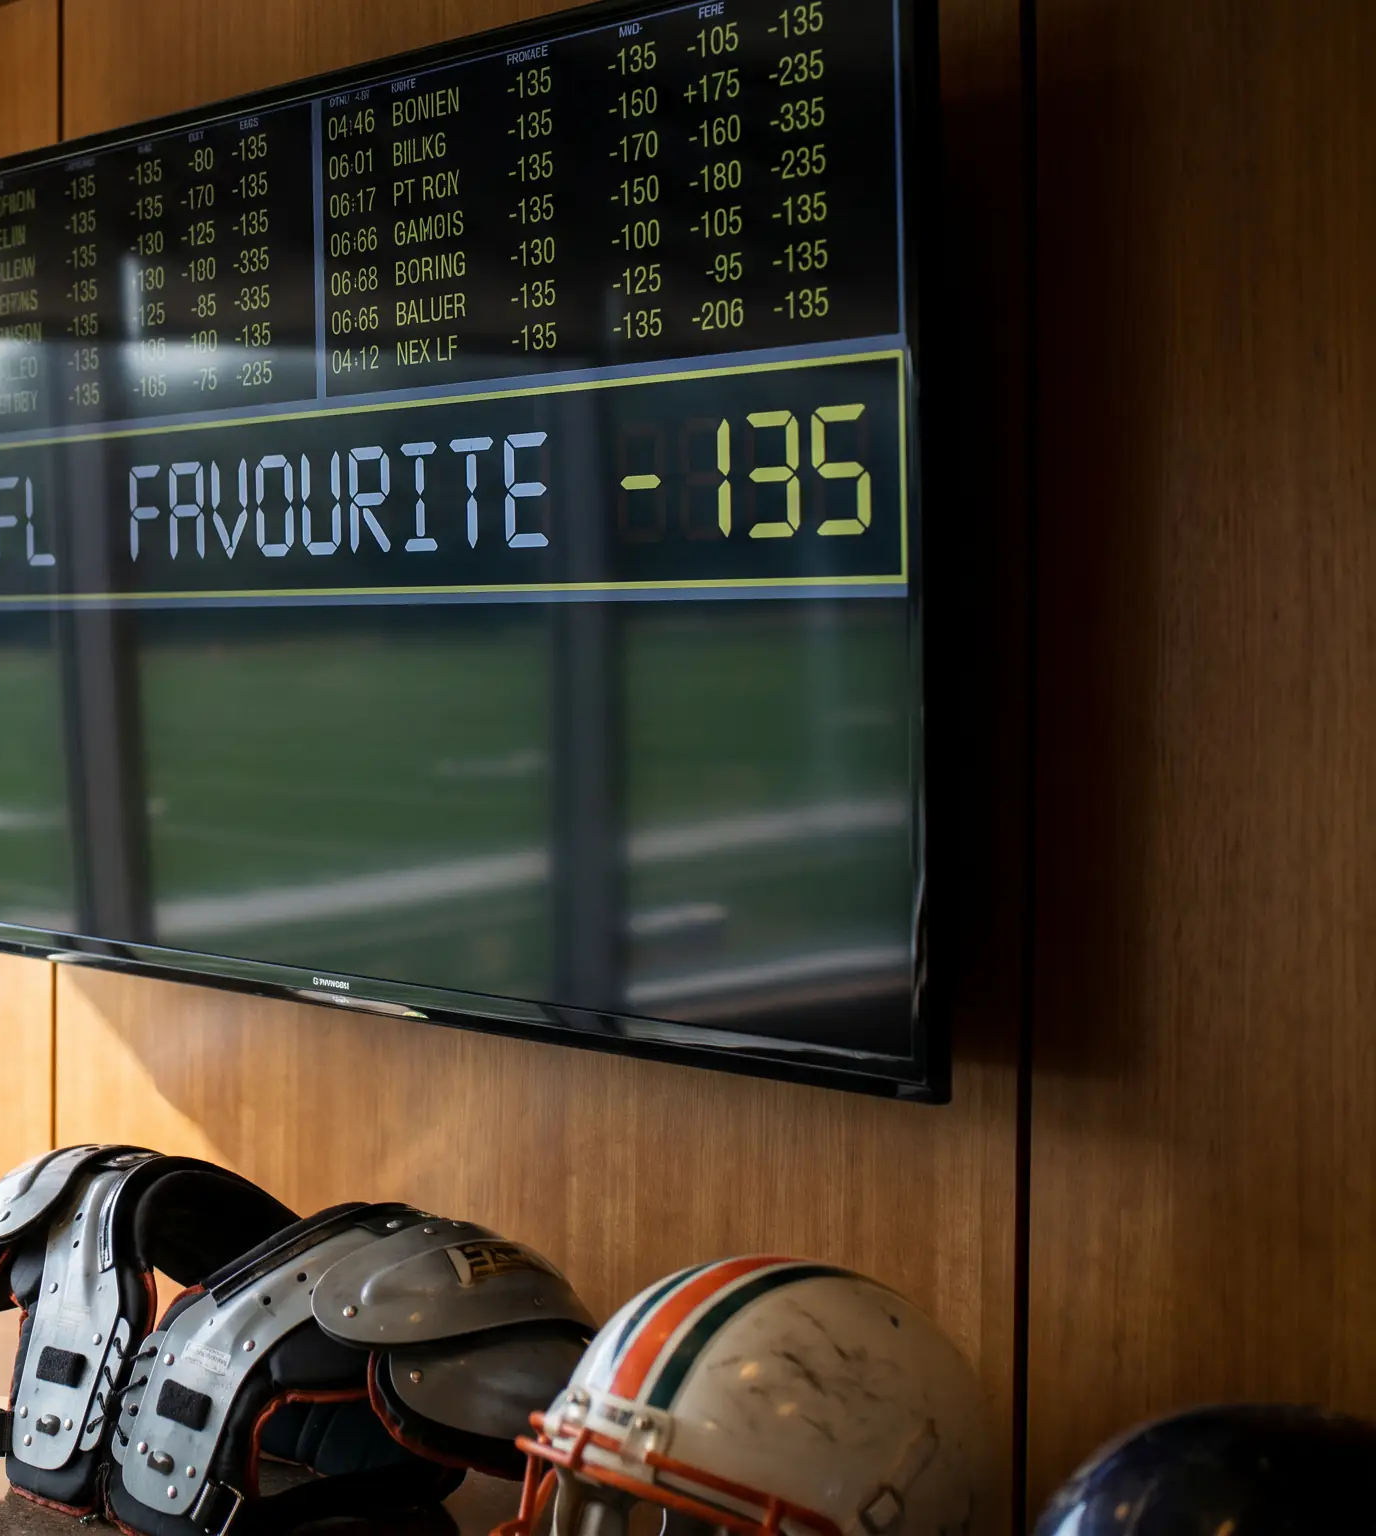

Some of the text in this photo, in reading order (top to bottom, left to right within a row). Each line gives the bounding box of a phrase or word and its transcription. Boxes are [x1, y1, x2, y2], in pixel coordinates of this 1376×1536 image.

[328, 1, 824, 141] 04:46 BONIEN -135 -135 -105 -135
[329, 148, 374, 180] 06:01
[508, 108, 552, 140] -135
[684, 68, 740, 104] +175
[768, 49, 824, 86] -235
[65, 174, 96, 199] -135
[129, 159, 162, 186] -135
[188, 147, 214, 172] -80
[232, 134, 268, 162] -135
[330, 187, 376, 218] 06:17
[394, 179, 416, 207] PT
[508, 151, 553, 182] -135
[610, 130, 658, 163] -170
[688, 114, 740, 148] -160
[770, 97, 825, 132] -335
[331, 144, 826, 257] 06:66 GAMOIS -135 -150 -180 -235
[65, 210, 96, 234] -135
[130, 195, 164, 220] -135
[180, 184, 214, 210] -170
[232, 172, 268, 198] -135
[66, 244, 97, 270] -135
[130, 230, 164, 256] -130
[181, 220, 215, 246] -125
[232, 209, 269, 236] -135
[332, 192, 828, 297] 06:68 BORING -130 -100 -105 -135
[66, 279, 98, 302] -135
[182, 257, 216, 283] -180
[233, 246, 270, 274] -335
[67, 313, 98, 336] -135
[191, 294, 216, 318] -85
[234, 284, 270, 311] -335
[332, 239, 828, 335] 06:65 BALUER -135 -125 -95 -135
[68, 348, 99, 372] -135
[235, 322, 271, 348] -135
[332, 287, 829, 374] 04:12 NEX LF -135 -135 -206 -135
[68, 382, 100, 406] -135
[193, 367, 218, 391] -75
[236, 360, 272, 386] -235
[129, 431, 548, 560] FAVOURITE
[620, 403, 872, 538] -135
